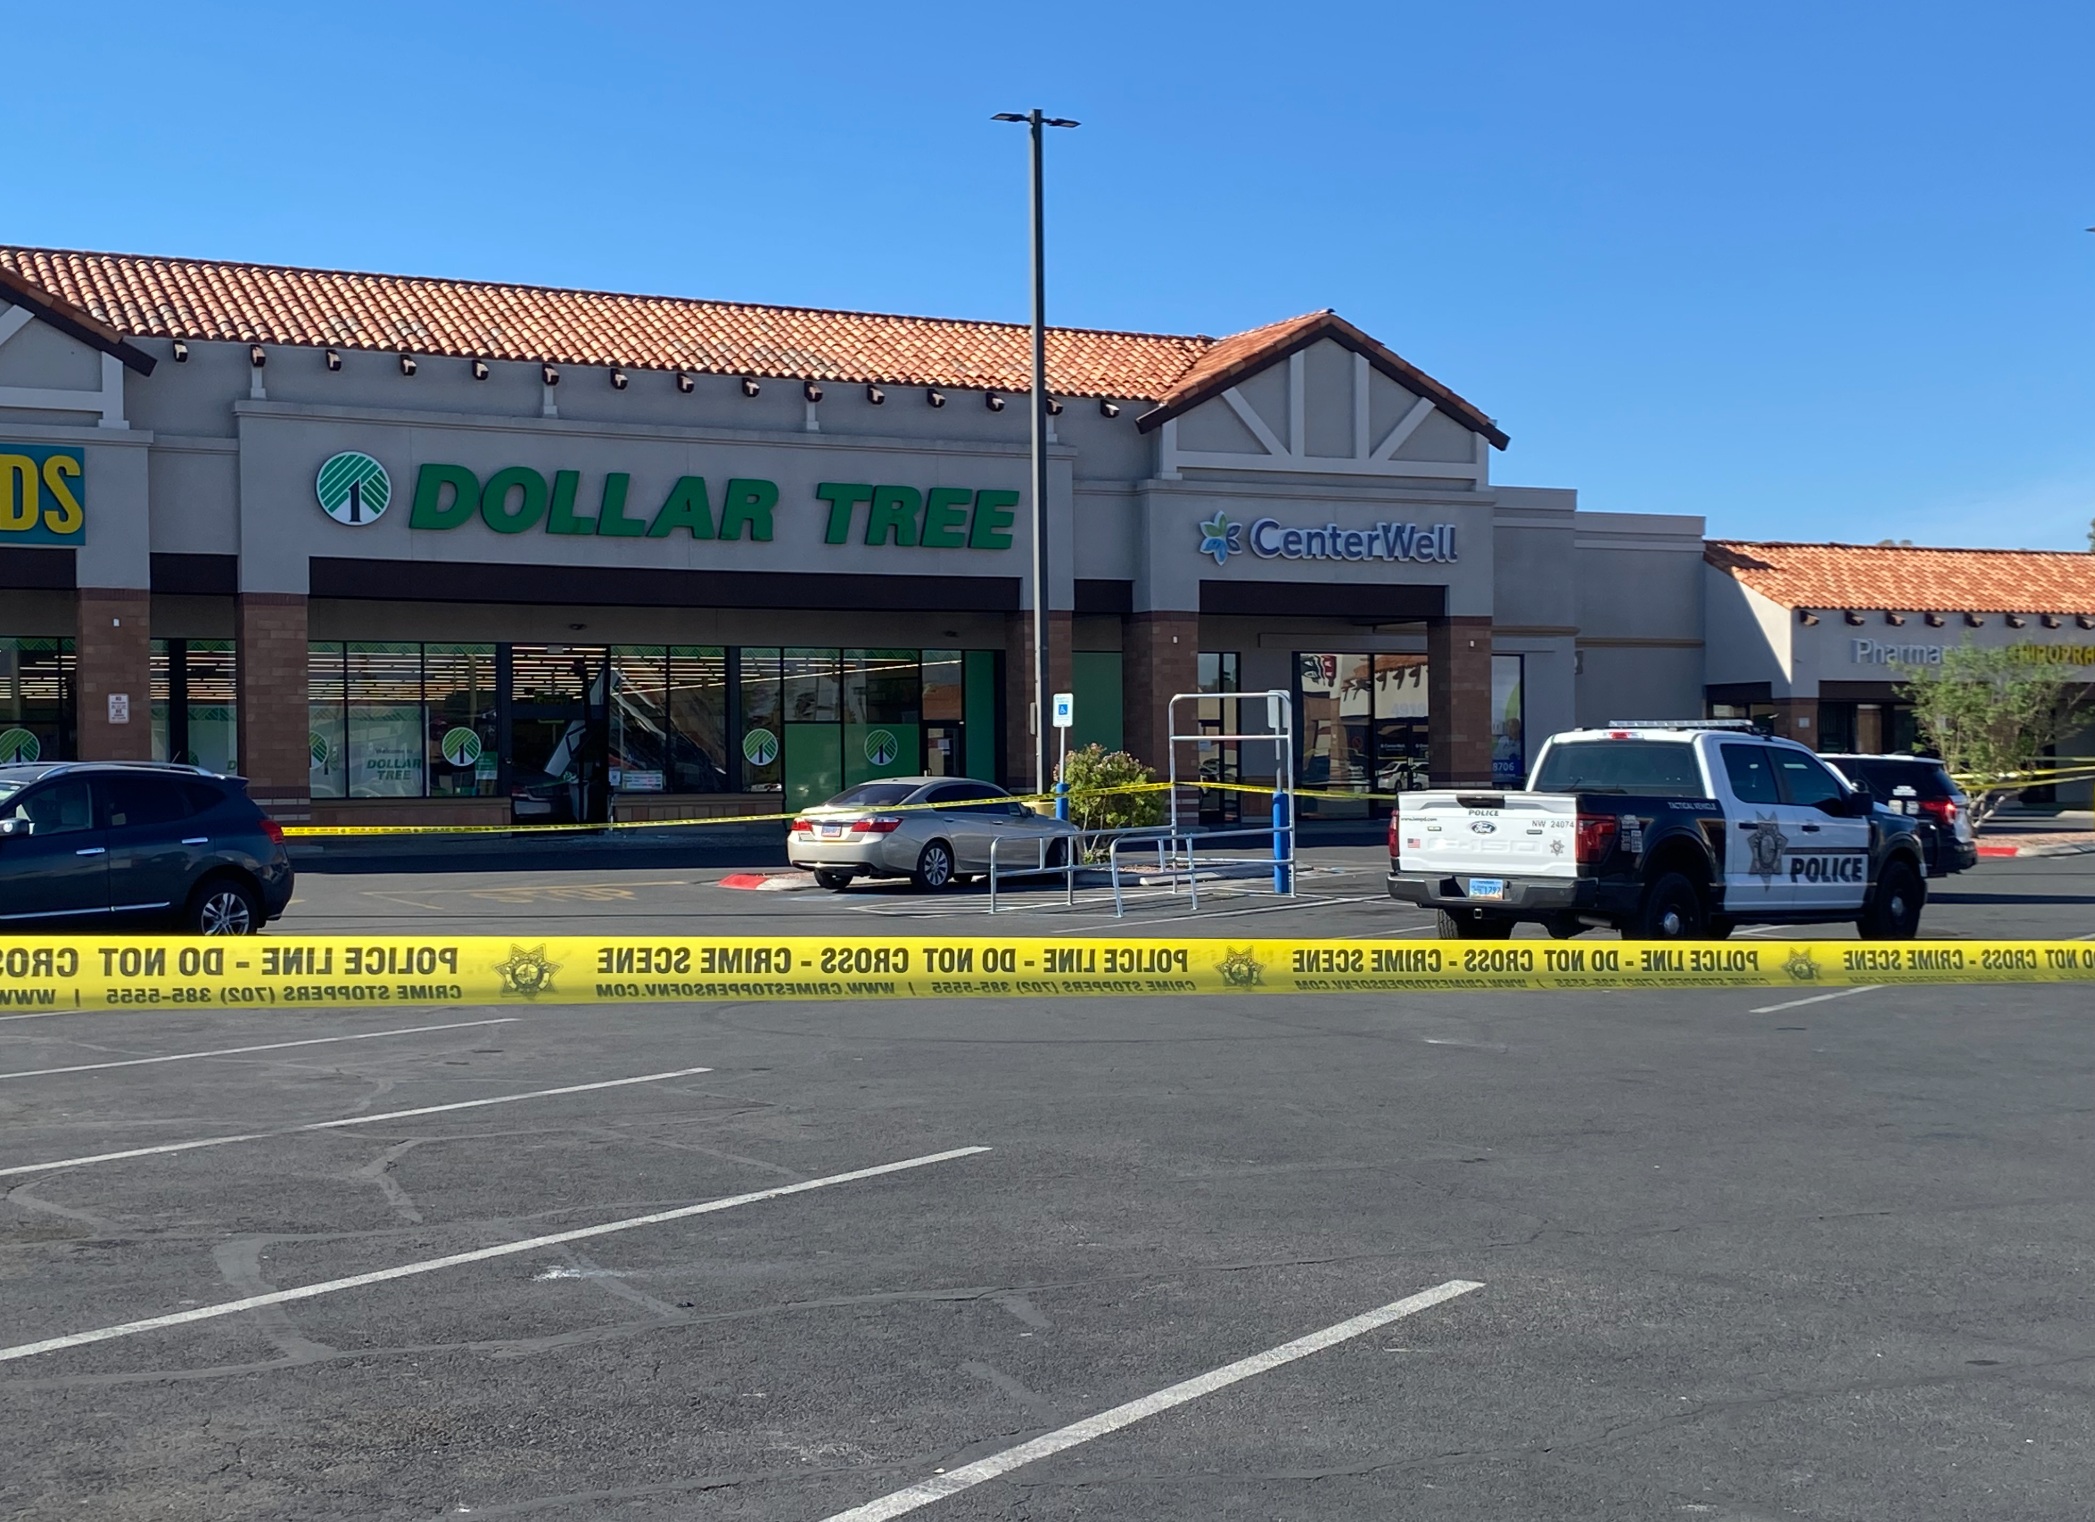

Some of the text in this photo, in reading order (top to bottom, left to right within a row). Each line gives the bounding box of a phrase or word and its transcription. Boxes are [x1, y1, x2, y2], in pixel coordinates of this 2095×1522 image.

[0, 454, 83, 534] DS
[409, 463, 1020, 550] DOLLAR TREE
[1250, 517, 1458, 564] CenterWell
[367, 759, 421, 769] DOLLAR
[377, 770, 412, 780] TREE
[1468, 809, 1499, 817] POLICE
[1551, 820, 1575, 829] 24074
[1790, 857, 1862, 883] POLICE
